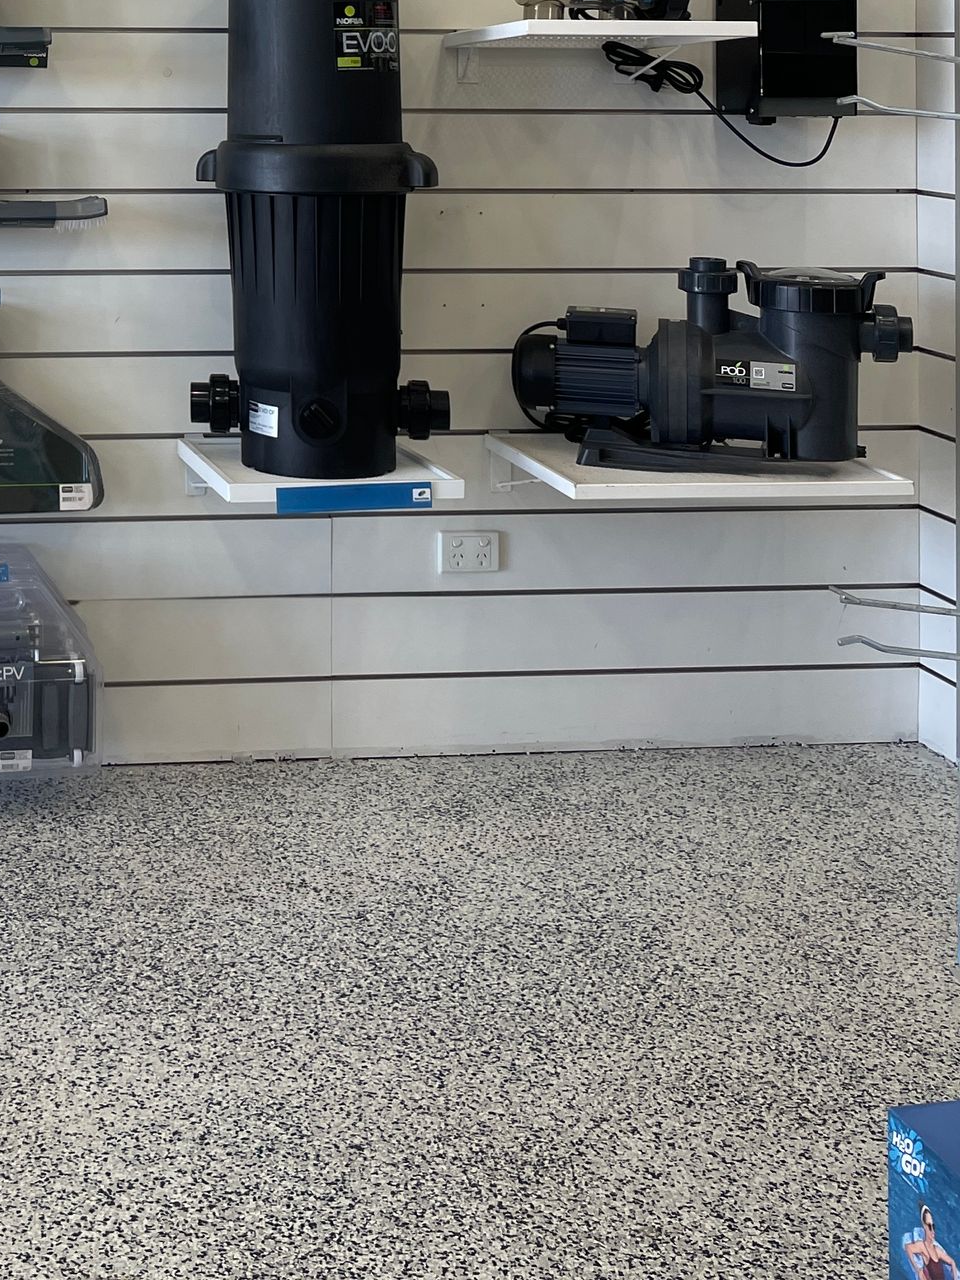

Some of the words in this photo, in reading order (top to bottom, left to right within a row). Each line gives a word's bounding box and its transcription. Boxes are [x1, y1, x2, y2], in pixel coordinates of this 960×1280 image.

[336, 17, 363, 25] NORIA
[720, 365, 746, 376] POD
[901, 1153, 926, 1179] GO!
